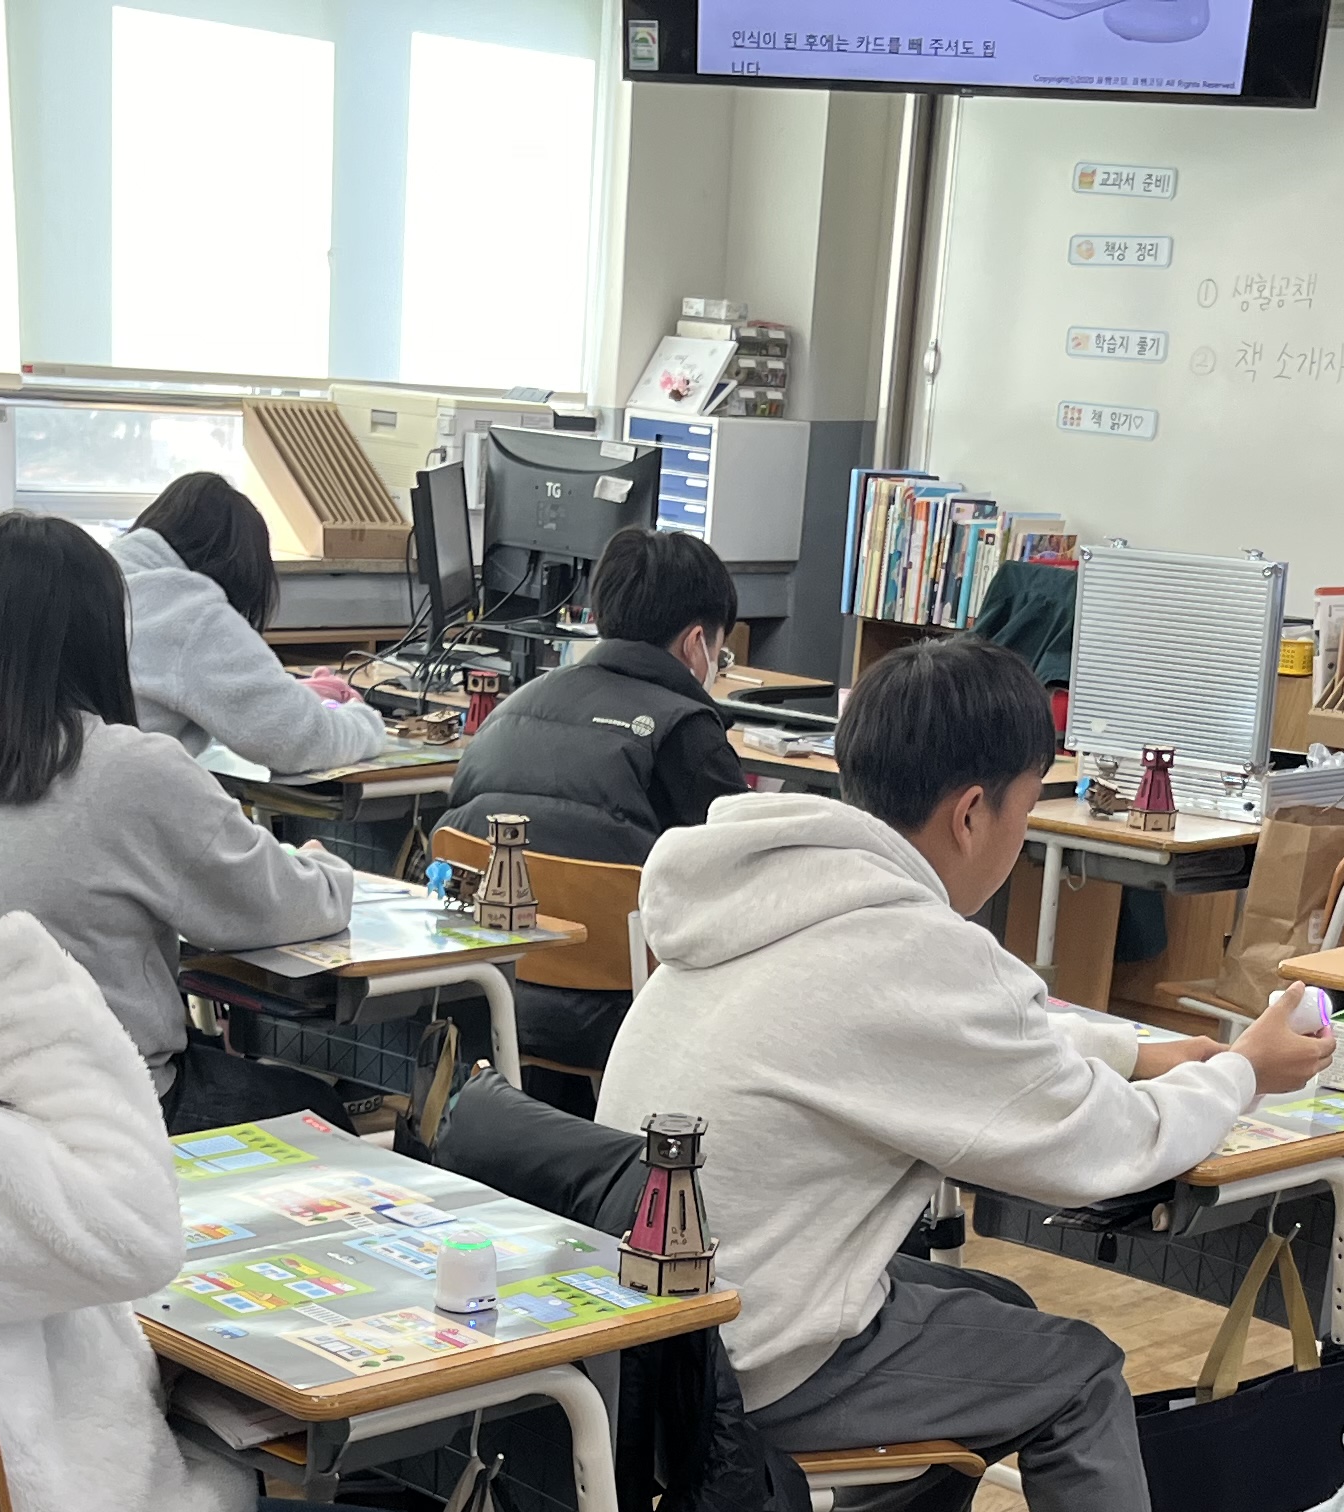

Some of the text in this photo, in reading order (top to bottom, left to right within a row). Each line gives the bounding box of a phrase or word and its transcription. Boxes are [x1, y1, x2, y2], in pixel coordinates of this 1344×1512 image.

[732, 30, 776, 49] 인식이
[784, 32, 798, 49] 된
[805, 34, 849, 52] 후에는
[856, 35, 901, 54] 카드를
[1099, 171, 1171, 193] 교과서 준비!
[1103, 241, 1159, 262] 책상 정리
[1232, 273, 1318, 312] 생활공책
[1095, 333, 1160, 356] 학습지 풀기
[1235, 342, 1263, 383] 책
[1091, 410, 1102, 427] 책
[546, 482, 561, 498] TG
